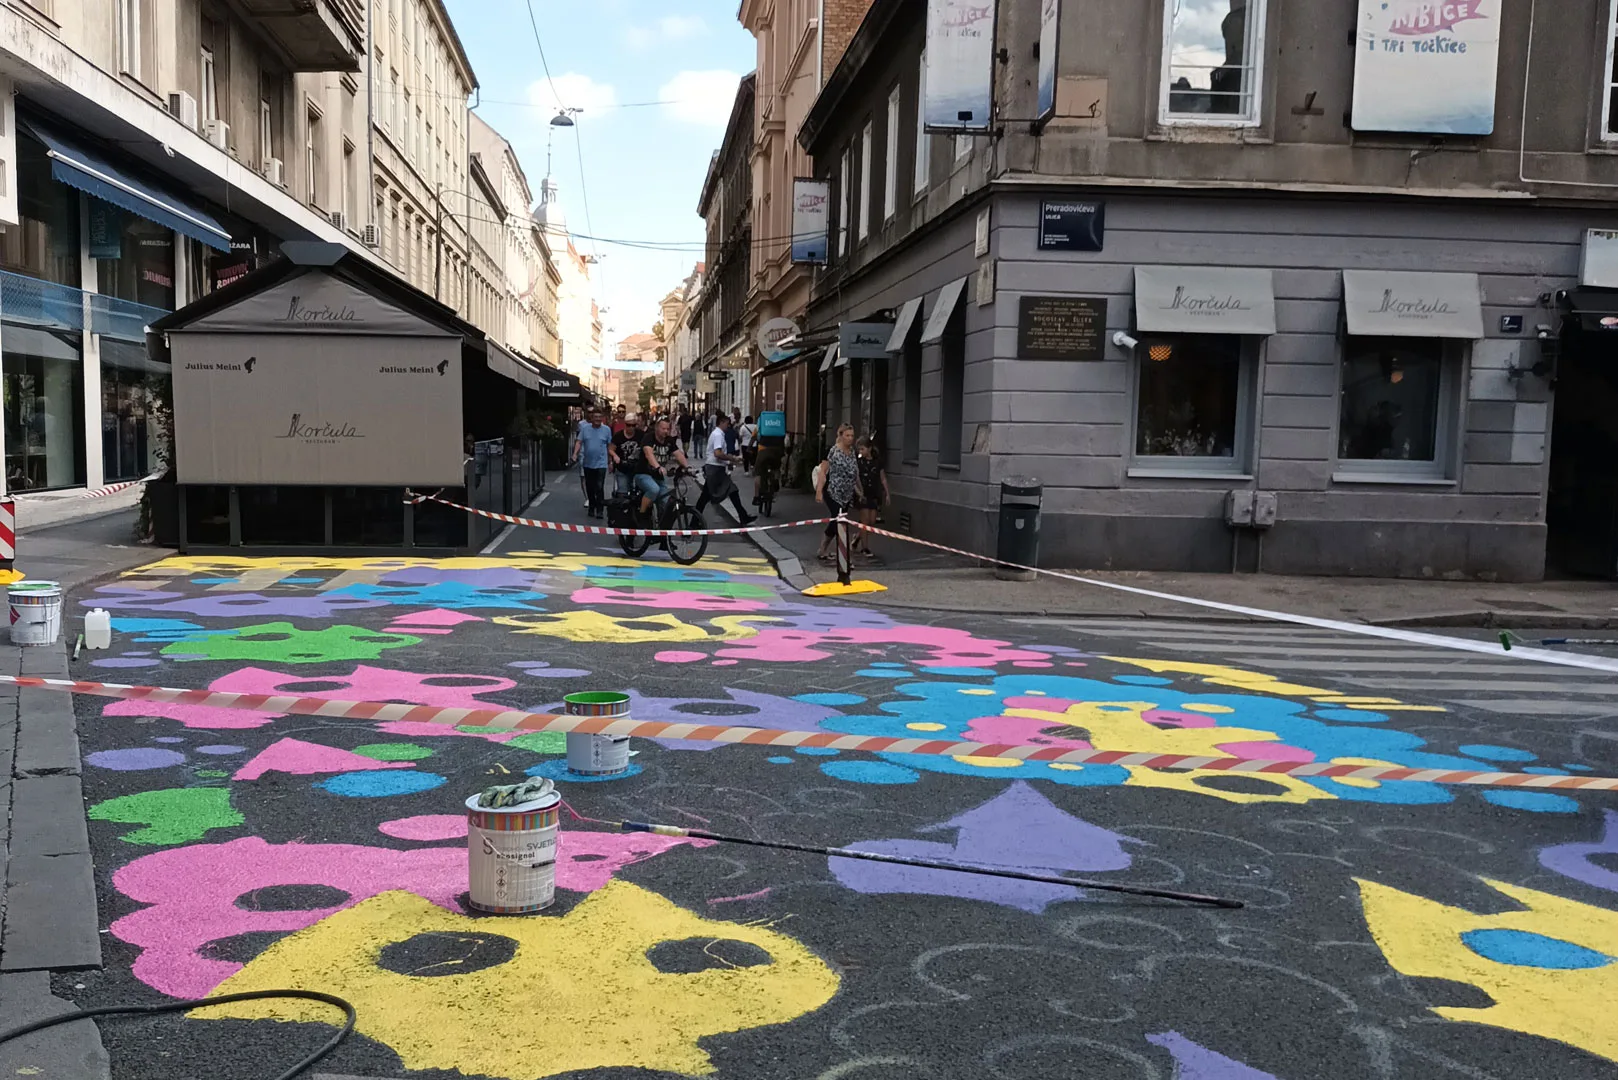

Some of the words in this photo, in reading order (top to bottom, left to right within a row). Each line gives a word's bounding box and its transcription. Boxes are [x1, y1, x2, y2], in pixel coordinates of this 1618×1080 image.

[1045, 204, 1095, 213] Preradovićeva
[1161, 285, 1248, 311] Korčula
[1371, 288, 1456, 314] Korčula
[277, 295, 362, 321] Korčula
[1503, 316, 1511, 325] 7
[184, 362, 214, 370] Julius
[216, 363, 242, 371] Meinl
[409, 366, 435, 374] Meinl
[551, 379, 570, 388] Jana
[278, 413, 363, 438] Korčula
